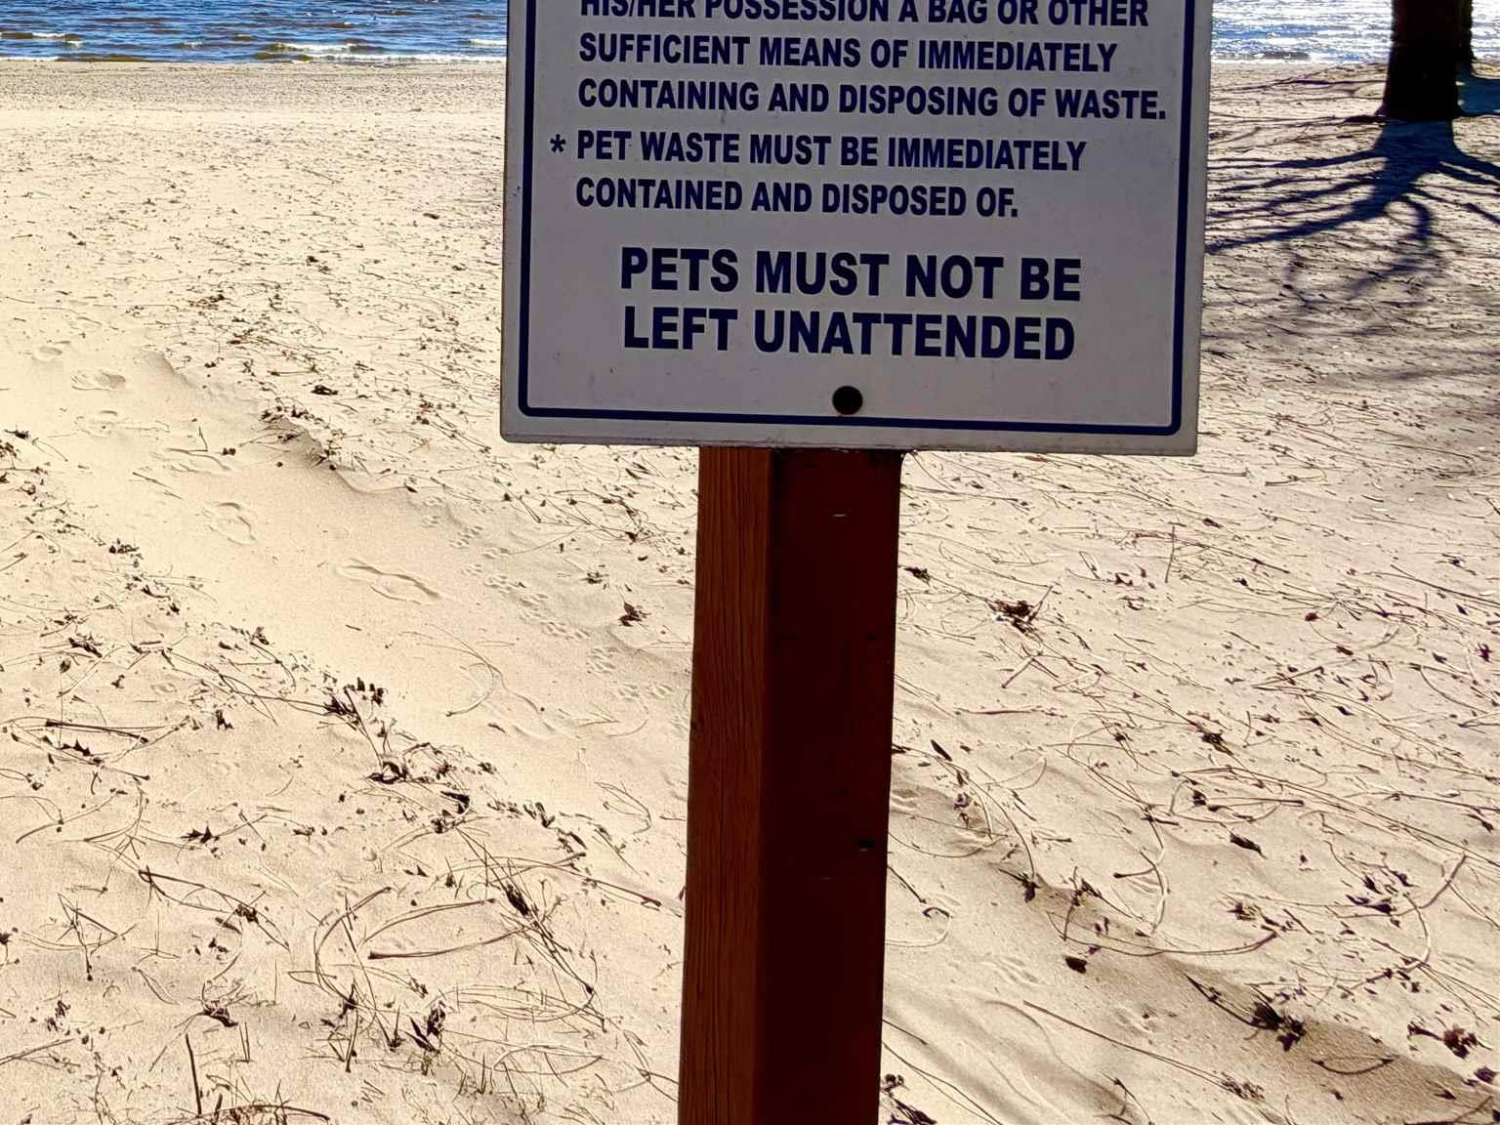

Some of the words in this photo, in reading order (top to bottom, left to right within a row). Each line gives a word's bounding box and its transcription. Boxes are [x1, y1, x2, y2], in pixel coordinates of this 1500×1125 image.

[579, 32, 751, 65] SUFFICIENT
[759, 36, 861, 68] MEANS
[870, 38, 909, 69] OF
[918, 39, 1118, 73] IMMEDIATELY
[578, 78, 759, 112] CONTAINING
[767, 83, 830, 113] AND
[839, 84, 998, 117] DISPOSING
[1008, 87, 1047, 118] OF
[1054, 88, 1166, 120] WASTE.
[577, 129, 632, 161] PET
[640, 131, 740, 163] WASTE
[749, 133, 832, 166] MUST
[840, 136, 879, 167] BE
[888, 137, 1087, 172] IMMEDIATELY
[576, 176, 743, 211] CONTAINED
[750, 181, 813, 213] AND
[822, 183, 967, 216] DISPOSED
[976, 186, 1018, 218] OF.
[621, 246, 739, 293] PETS
[755, 250, 890, 297] MUST
[905, 254, 1004, 300] NOT
[1020, 257, 1082, 302] BE
[624, 305, 738, 351] LEFT
[754, 309, 1075, 361] UNATTENDED
